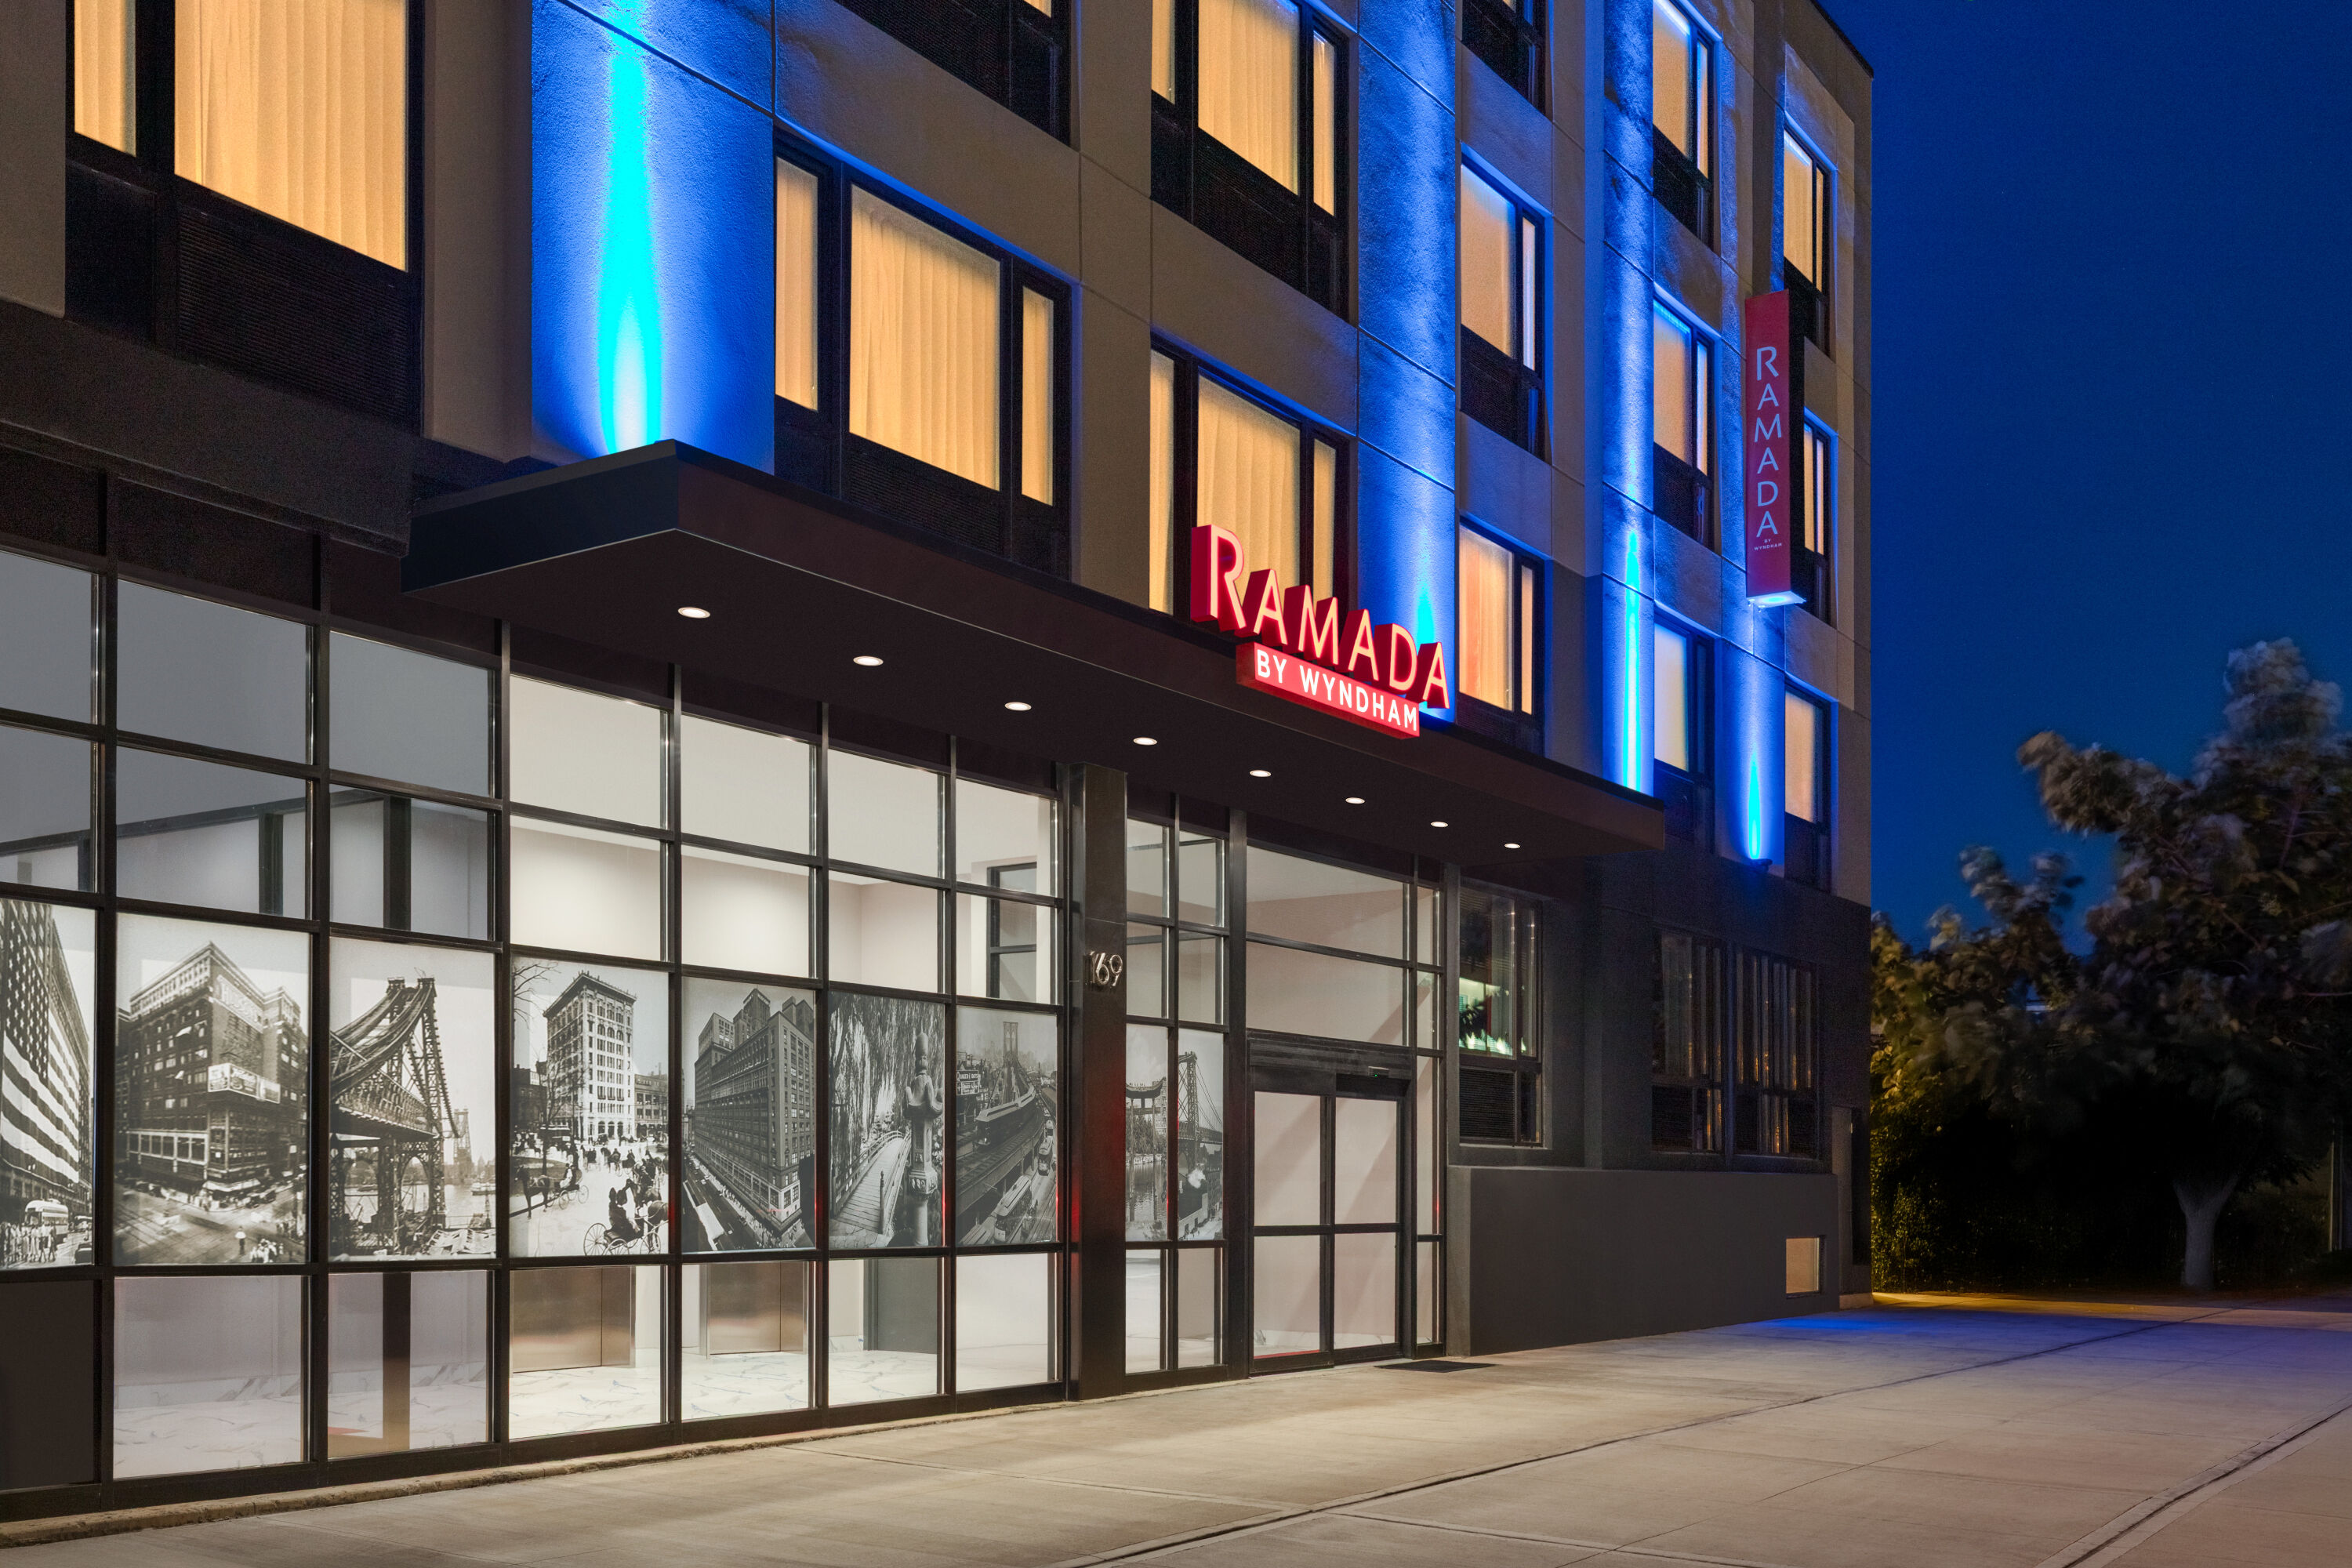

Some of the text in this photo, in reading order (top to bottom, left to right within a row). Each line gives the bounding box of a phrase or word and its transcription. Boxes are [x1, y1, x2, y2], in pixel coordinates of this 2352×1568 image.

[1754, 346, 1782, 538] RAMADA
[1754, 543, 1782, 551] WYNDHAM
[1208, 524, 1450, 710] RAMADA
[1257, 649, 1417, 731] BY WYNDHAM
[1090, 950, 1123, 987] 169
